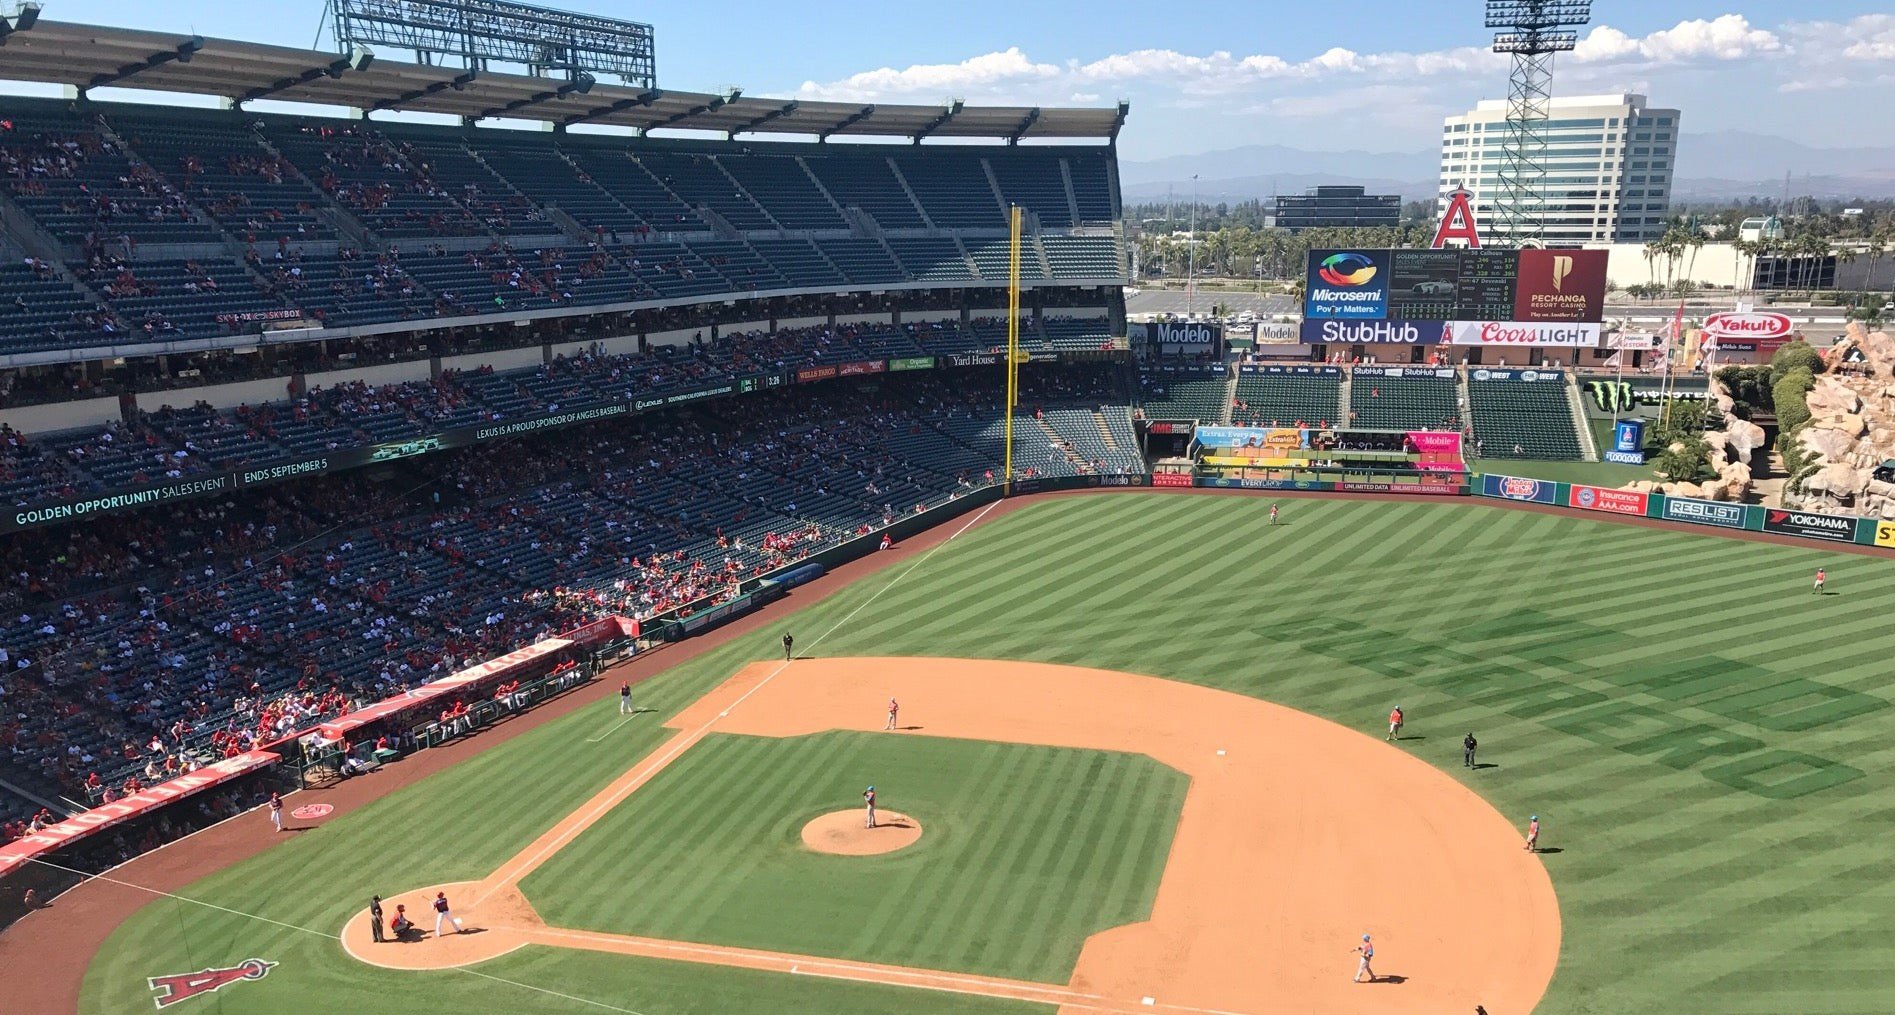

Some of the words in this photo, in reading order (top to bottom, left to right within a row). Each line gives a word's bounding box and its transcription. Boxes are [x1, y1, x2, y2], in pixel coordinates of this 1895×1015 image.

[1531, 294, 1586, 303] PECHANGA
[269, 310, 300, 319] SKYBOX
[1316, 305, 1342, 313] Poer
[1719, 319, 1777, 331] Yakult
[1157, 323, 1211, 343] Modelo
[1262, 327, 1295, 339] Modelo
[1322, 321, 1419, 342] StubHub
[1480, 322, 1537, 343] Coors
[1539, 329, 1590, 343] LIGHT
[953, 355, 970, 366] Yard
[972, 355, 995, 365] House
[799, 370, 818, 379] WELLS
[818, 367, 836, 377] FARGO
[1353, 367, 1383, 375] StubHub
[1404, 368, 1434, 376] StubHub
[643, 399, 663, 408] LEXUS
[668, 394, 687, 403] SOUTHERN
[687, 390, 707, 400] CALIFORNIA
[476, 427, 499, 439] LEXUS
[500, 425, 506, 435] IS
[506, 424, 511, 434] A
[512, 420, 536, 433] PROUD
[536, 415, 566, 428] SPONSOR
[567, 413, 576, 422] OF
[576, 409, 599, 420] ANGELS
[600, 404, 626, 415] BASEBALL
[1425, 436, 1451, 445] Mobile
[244, 470, 269, 483] ENDS
[271, 460, 320, 477] SEPTEMBER
[322, 458, 327, 469] 5
[1100, 475, 1129, 485] Modelo
[1505, 477, 1534, 487] Jersey
[15, 503, 73, 525] GOLDEN
[75, 488, 160, 514] OPPORTUNITY
[162, 484, 192, 499] SALES
[194, 477, 225, 493] EVENT
[1600, 490, 1639, 502] Insurance
[1598, 500, 1639, 513] AAA.com
[1790, 513, 1849, 530] YOKOHAMA
[595, 622, 609, 633] INC.
[481, 647, 545, 673] 2017
[24, 775, 212, 846] WELCOME
